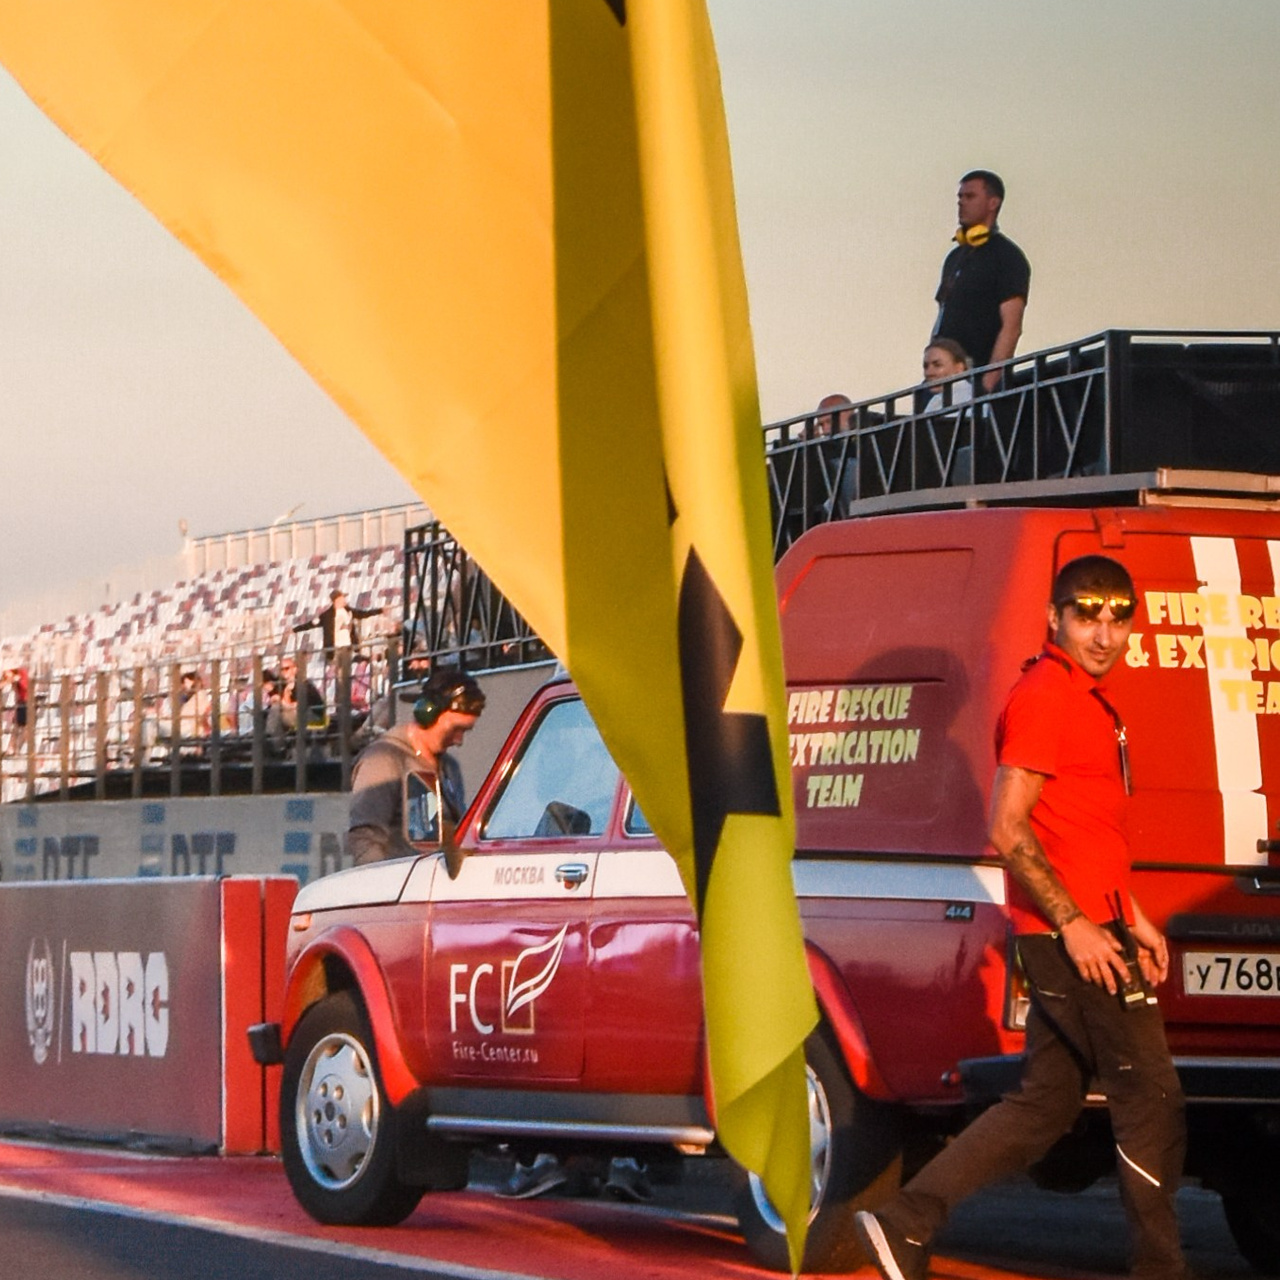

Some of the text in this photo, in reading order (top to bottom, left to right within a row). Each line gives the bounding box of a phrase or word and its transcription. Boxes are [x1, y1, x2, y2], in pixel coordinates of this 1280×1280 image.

[1144, 591, 1229, 627] FIRE
[1125, 633, 1150, 668] &
[788, 686, 913, 725] FIRE RESCUE
[806, 774, 864, 809] TEAM
[70, 950, 170, 1058] RDRC
[450, 963, 494, 1035] FC
[452, 1040, 539, 1063] Fire-Center.ru
